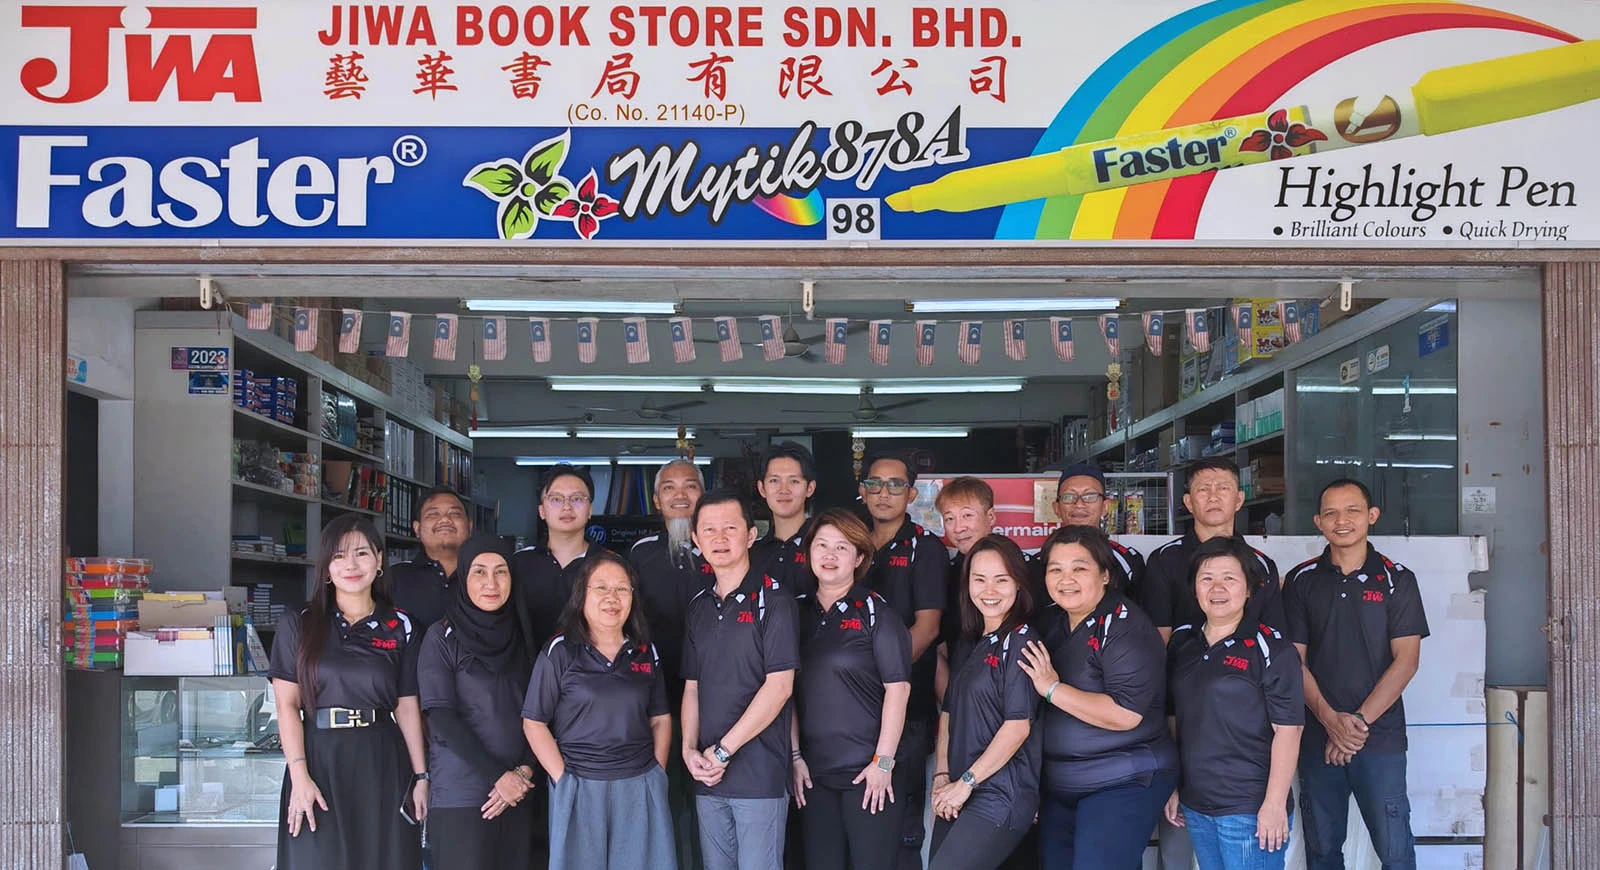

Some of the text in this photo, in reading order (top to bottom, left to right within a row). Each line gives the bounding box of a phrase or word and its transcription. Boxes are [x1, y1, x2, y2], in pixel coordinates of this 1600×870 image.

[318, 5, 1022, 48] JIWA BOOK STORE SDN. BHD.
[567, 103, 746, 125] (Co. No. 21140-P)
[606, 104, 970, 227] Mytik 878A
[1274, 163, 1577, 222] Highlight Pen
[832, 203, 876, 234] 98
[1290, 219, 1427, 238] Brilliant Colours
[1460, 219, 1569, 240] Quick Drying
[191, 350, 226, 365] 2023
[992, 522, 1061, 537] ermaid
